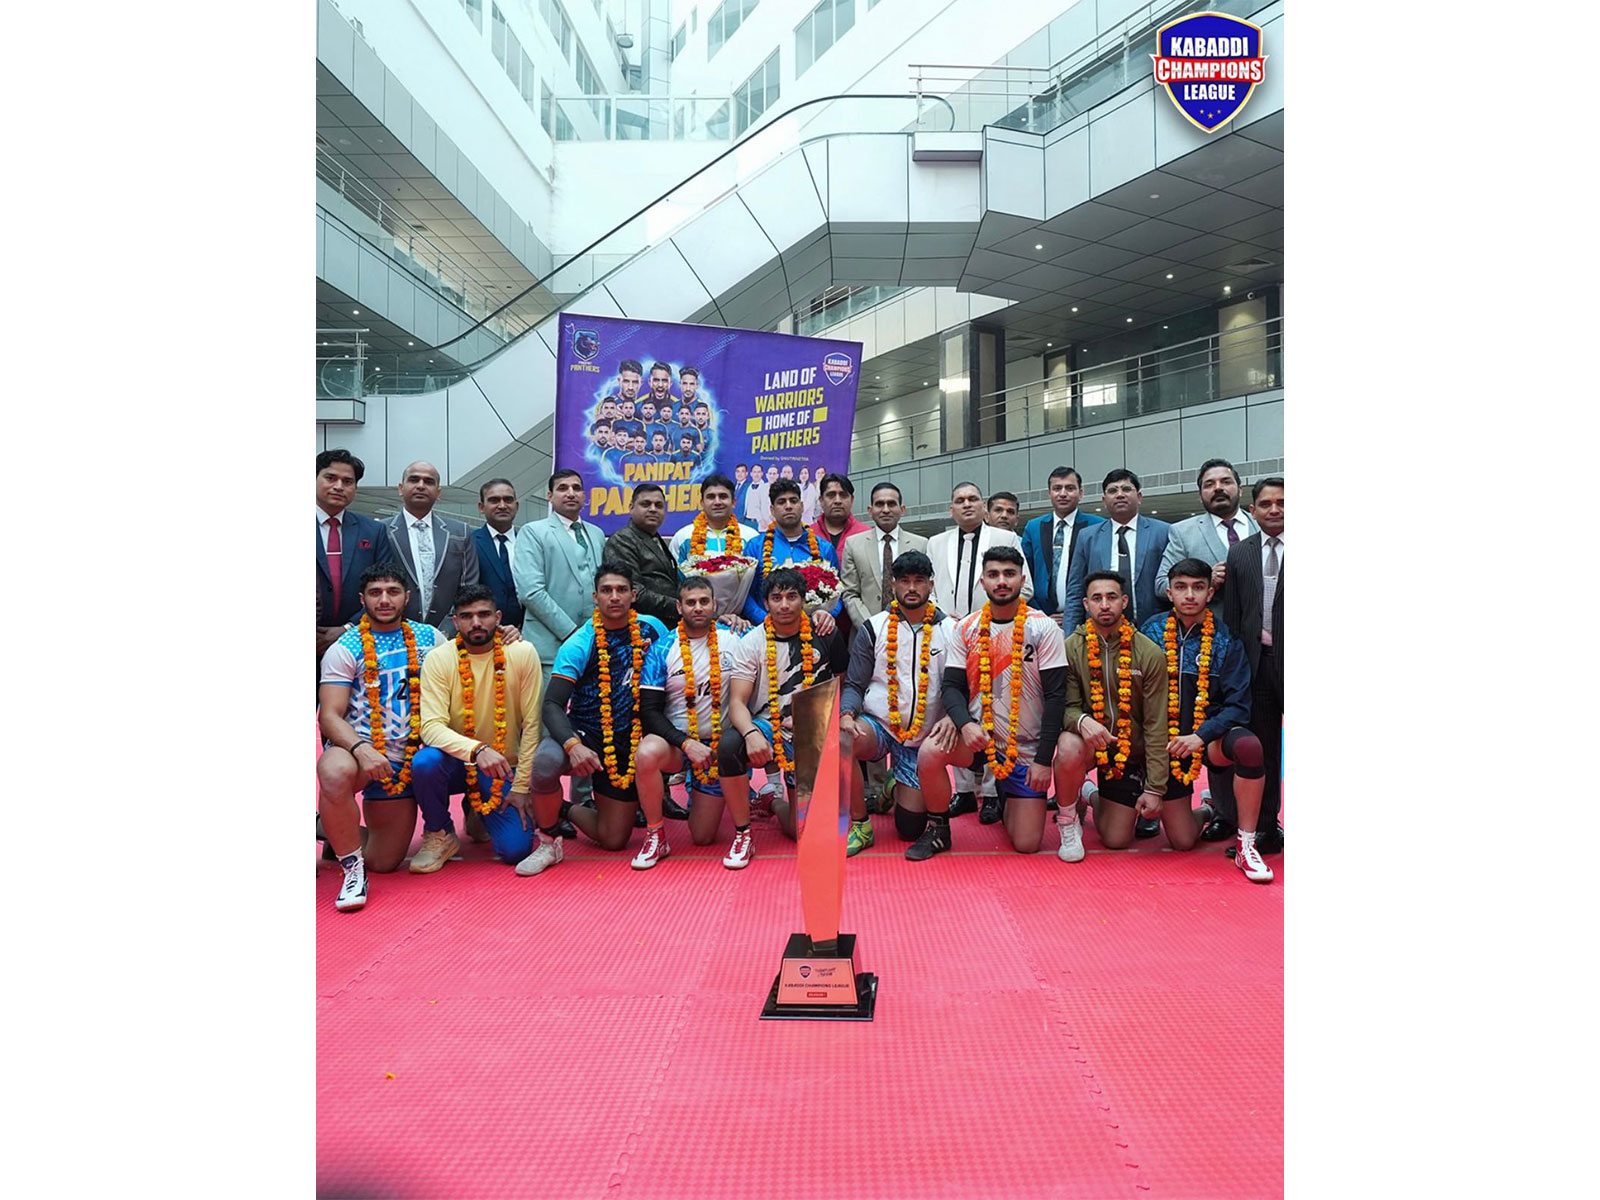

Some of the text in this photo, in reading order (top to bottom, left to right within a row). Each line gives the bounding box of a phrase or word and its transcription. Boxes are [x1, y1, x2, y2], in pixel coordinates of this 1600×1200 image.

[764, 366, 817, 391] LAND OF
[755, 387, 824, 414] WARRIORS
[764, 410, 811, 431] HOME OF
[751, 426, 821, 455] PANTHERS
[624, 461, 695, 482] PANIPAT
[589, 483, 704, 517] PAHER
[1024, 643, 1034, 662] 2
[397, 678, 408, 700] 2
[696, 680, 711, 696] 12
